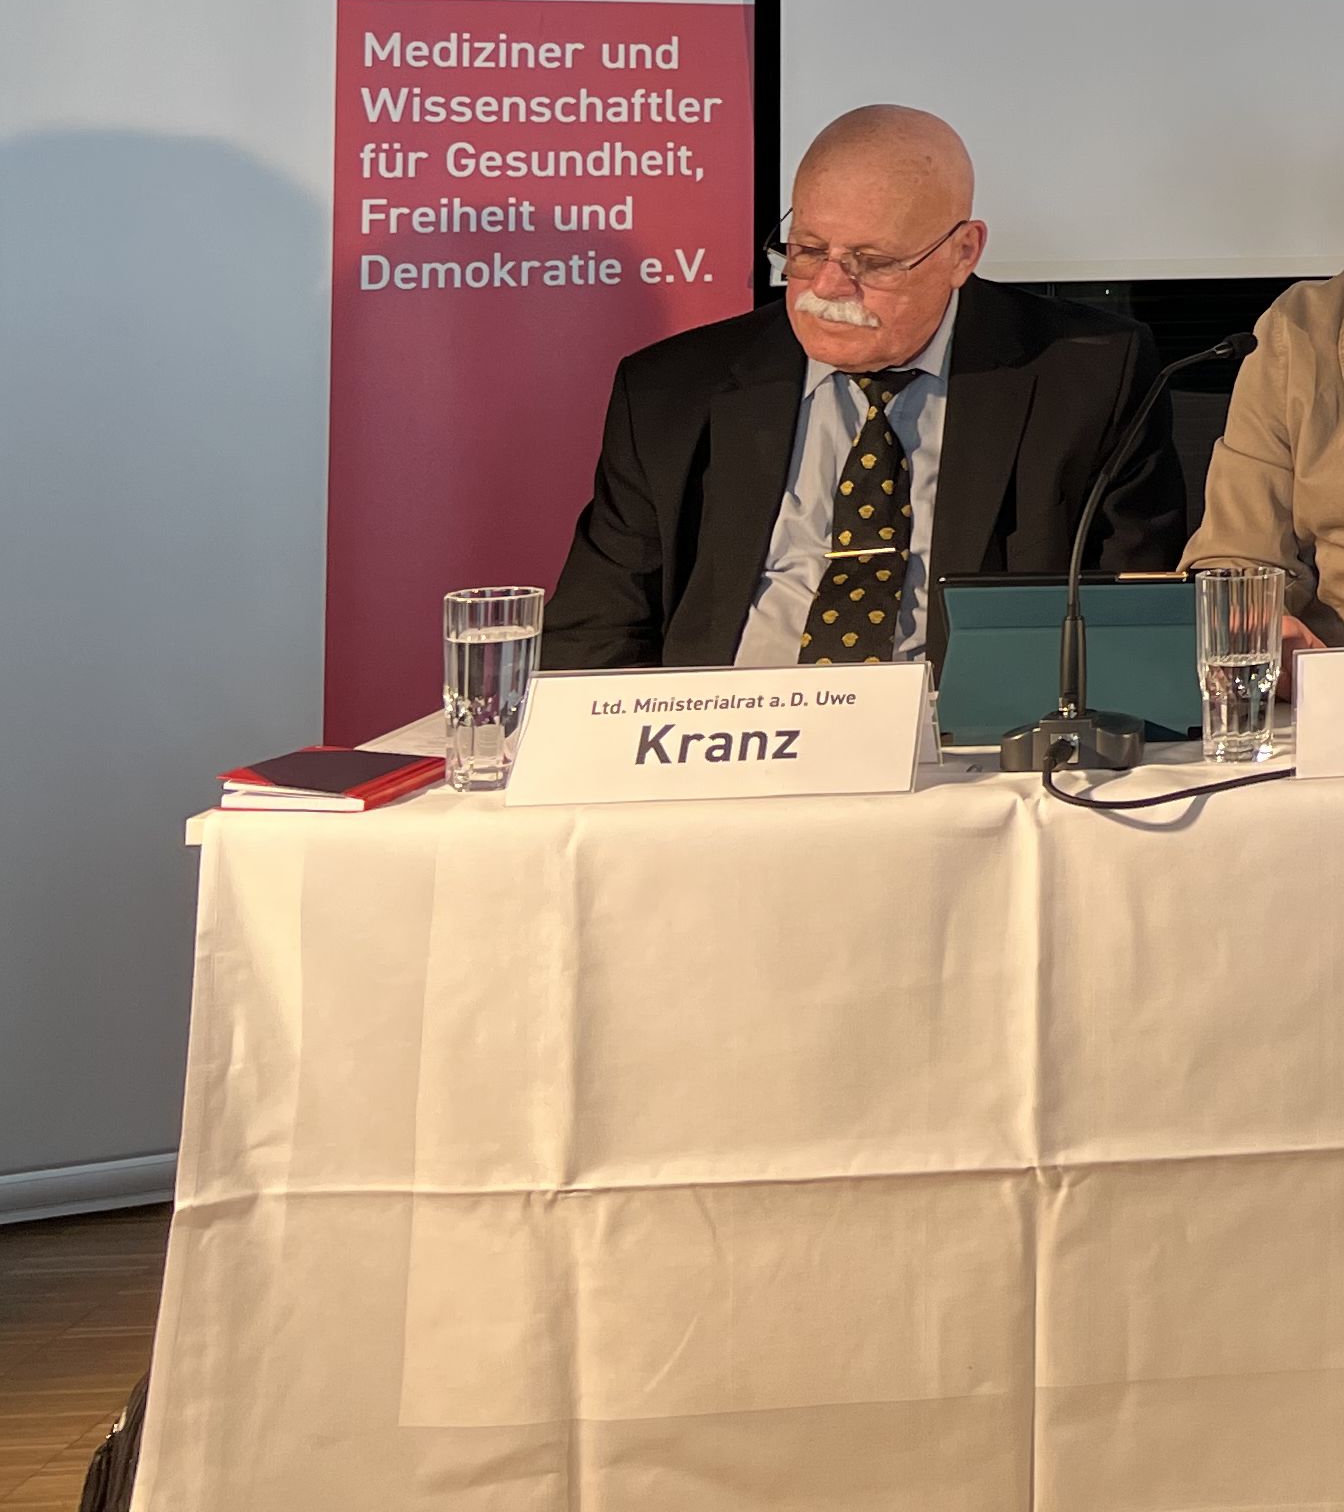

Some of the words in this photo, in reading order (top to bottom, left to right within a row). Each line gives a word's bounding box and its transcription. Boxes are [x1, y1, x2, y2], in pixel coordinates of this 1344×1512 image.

[364, 31, 585, 69] Mediziner
[601, 35, 679, 70] und
[360, 87, 723, 124] Wissenschaftler
[359, 142, 429, 179] für
[446, 141, 704, 182] Gesundheit,
[361, 196, 536, 234] Freiheit
[554, 195, 633, 231] und
[360, 250, 622, 291] Demokratie
[640, 248, 713, 284] e.V.
[591, 699, 627, 716] Ltd.
[633, 694, 765, 714] Ministerialrat
[769, 696, 786, 708] a.
[790, 692, 809, 707] D.
[816, 689, 857, 706] Uwe
[634, 723, 801, 765] Kranz
